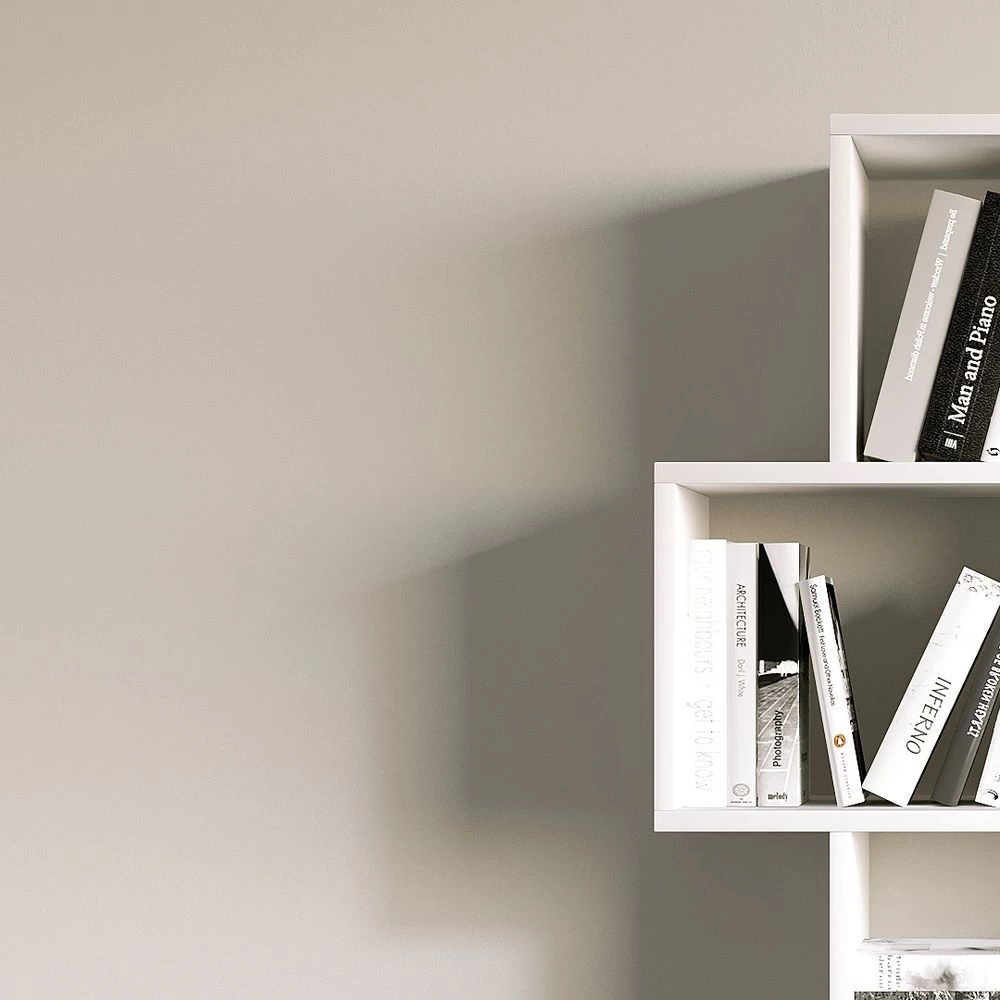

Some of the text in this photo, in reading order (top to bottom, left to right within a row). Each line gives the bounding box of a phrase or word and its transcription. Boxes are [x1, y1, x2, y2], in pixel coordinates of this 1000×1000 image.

[968, 293, 998, 345] Piano
[957, 345, 984, 381] and
[947, 382, 974, 424] Man
[736, 583, 747, 648] ARCHITECTURE
[808, 583, 824, 633] Samuel Beckett
[773, 710, 785, 767] Photography
[905, 677, 951, 755] INFERNO
